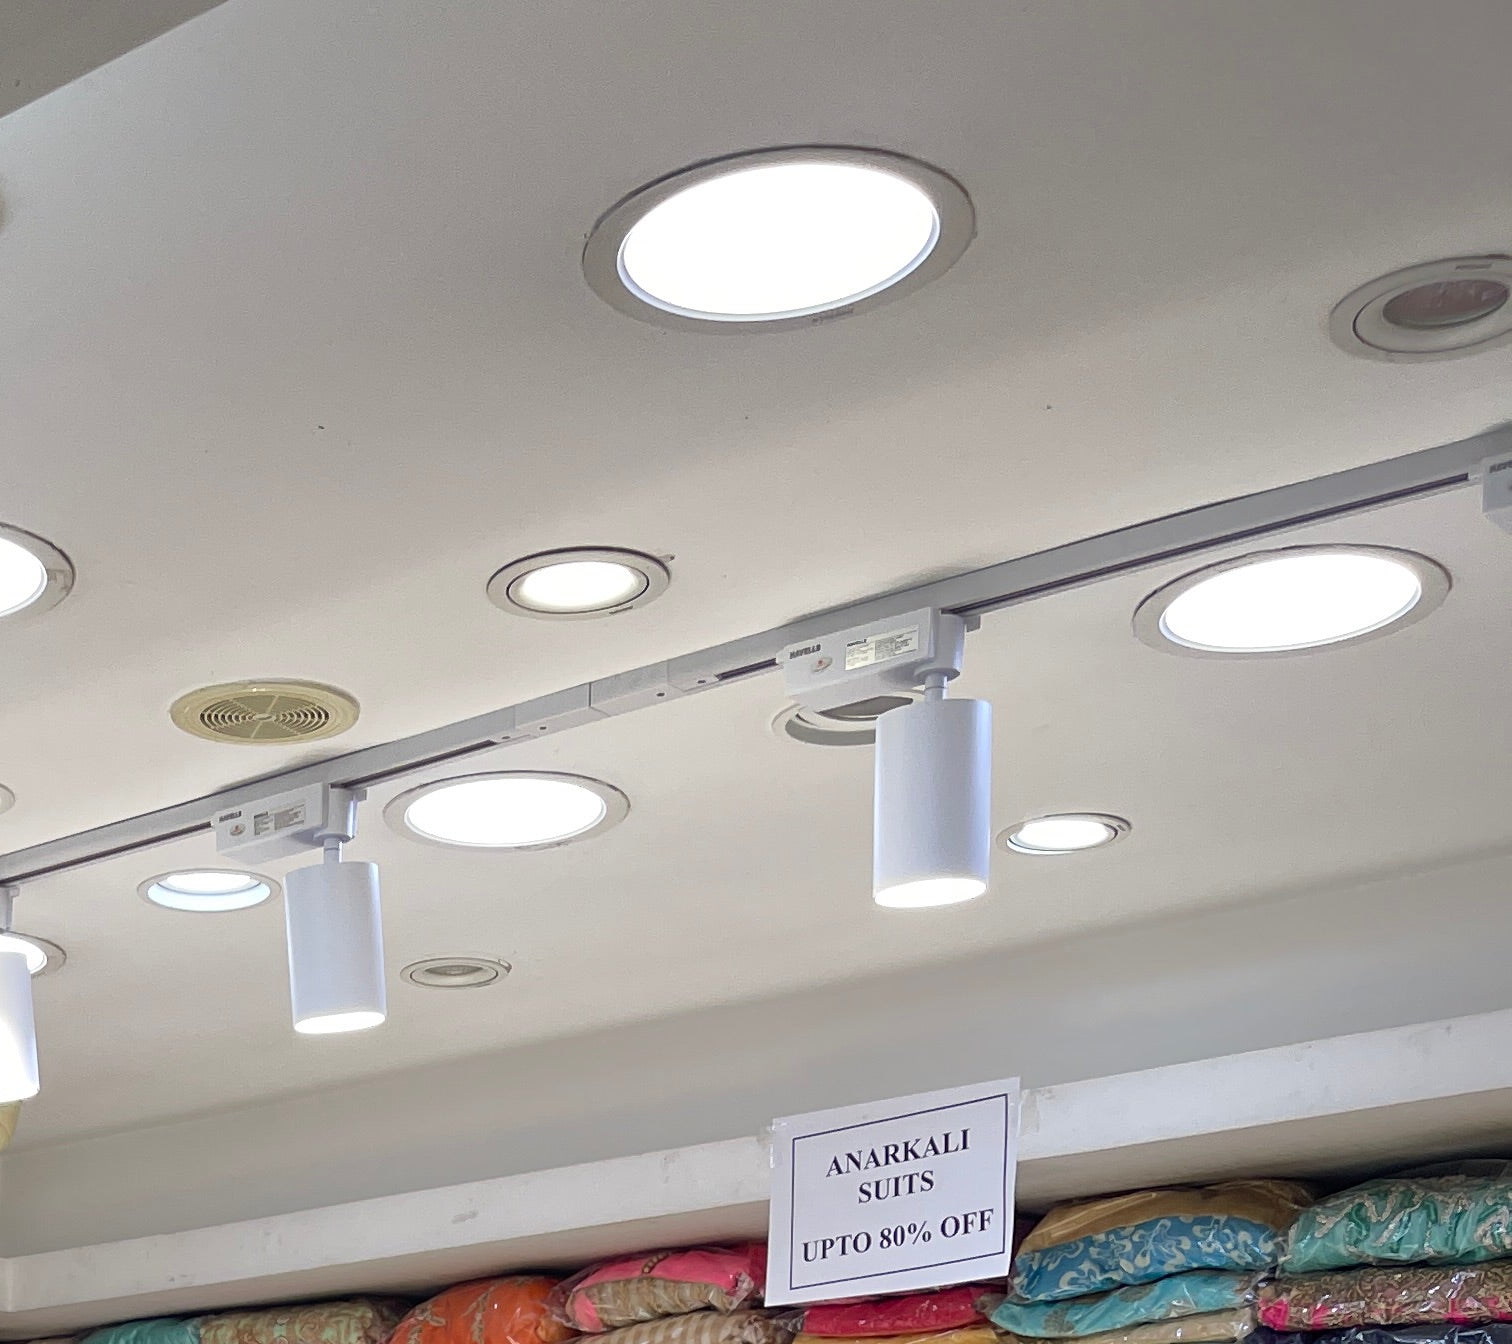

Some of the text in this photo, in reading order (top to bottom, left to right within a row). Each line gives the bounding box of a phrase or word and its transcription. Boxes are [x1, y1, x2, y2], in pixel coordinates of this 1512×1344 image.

[825, 1128, 971, 1178] ANARKALI
[858, 1170, 935, 1204] SUITS
[802, 1208, 995, 1263] UPTO 80% OFF
